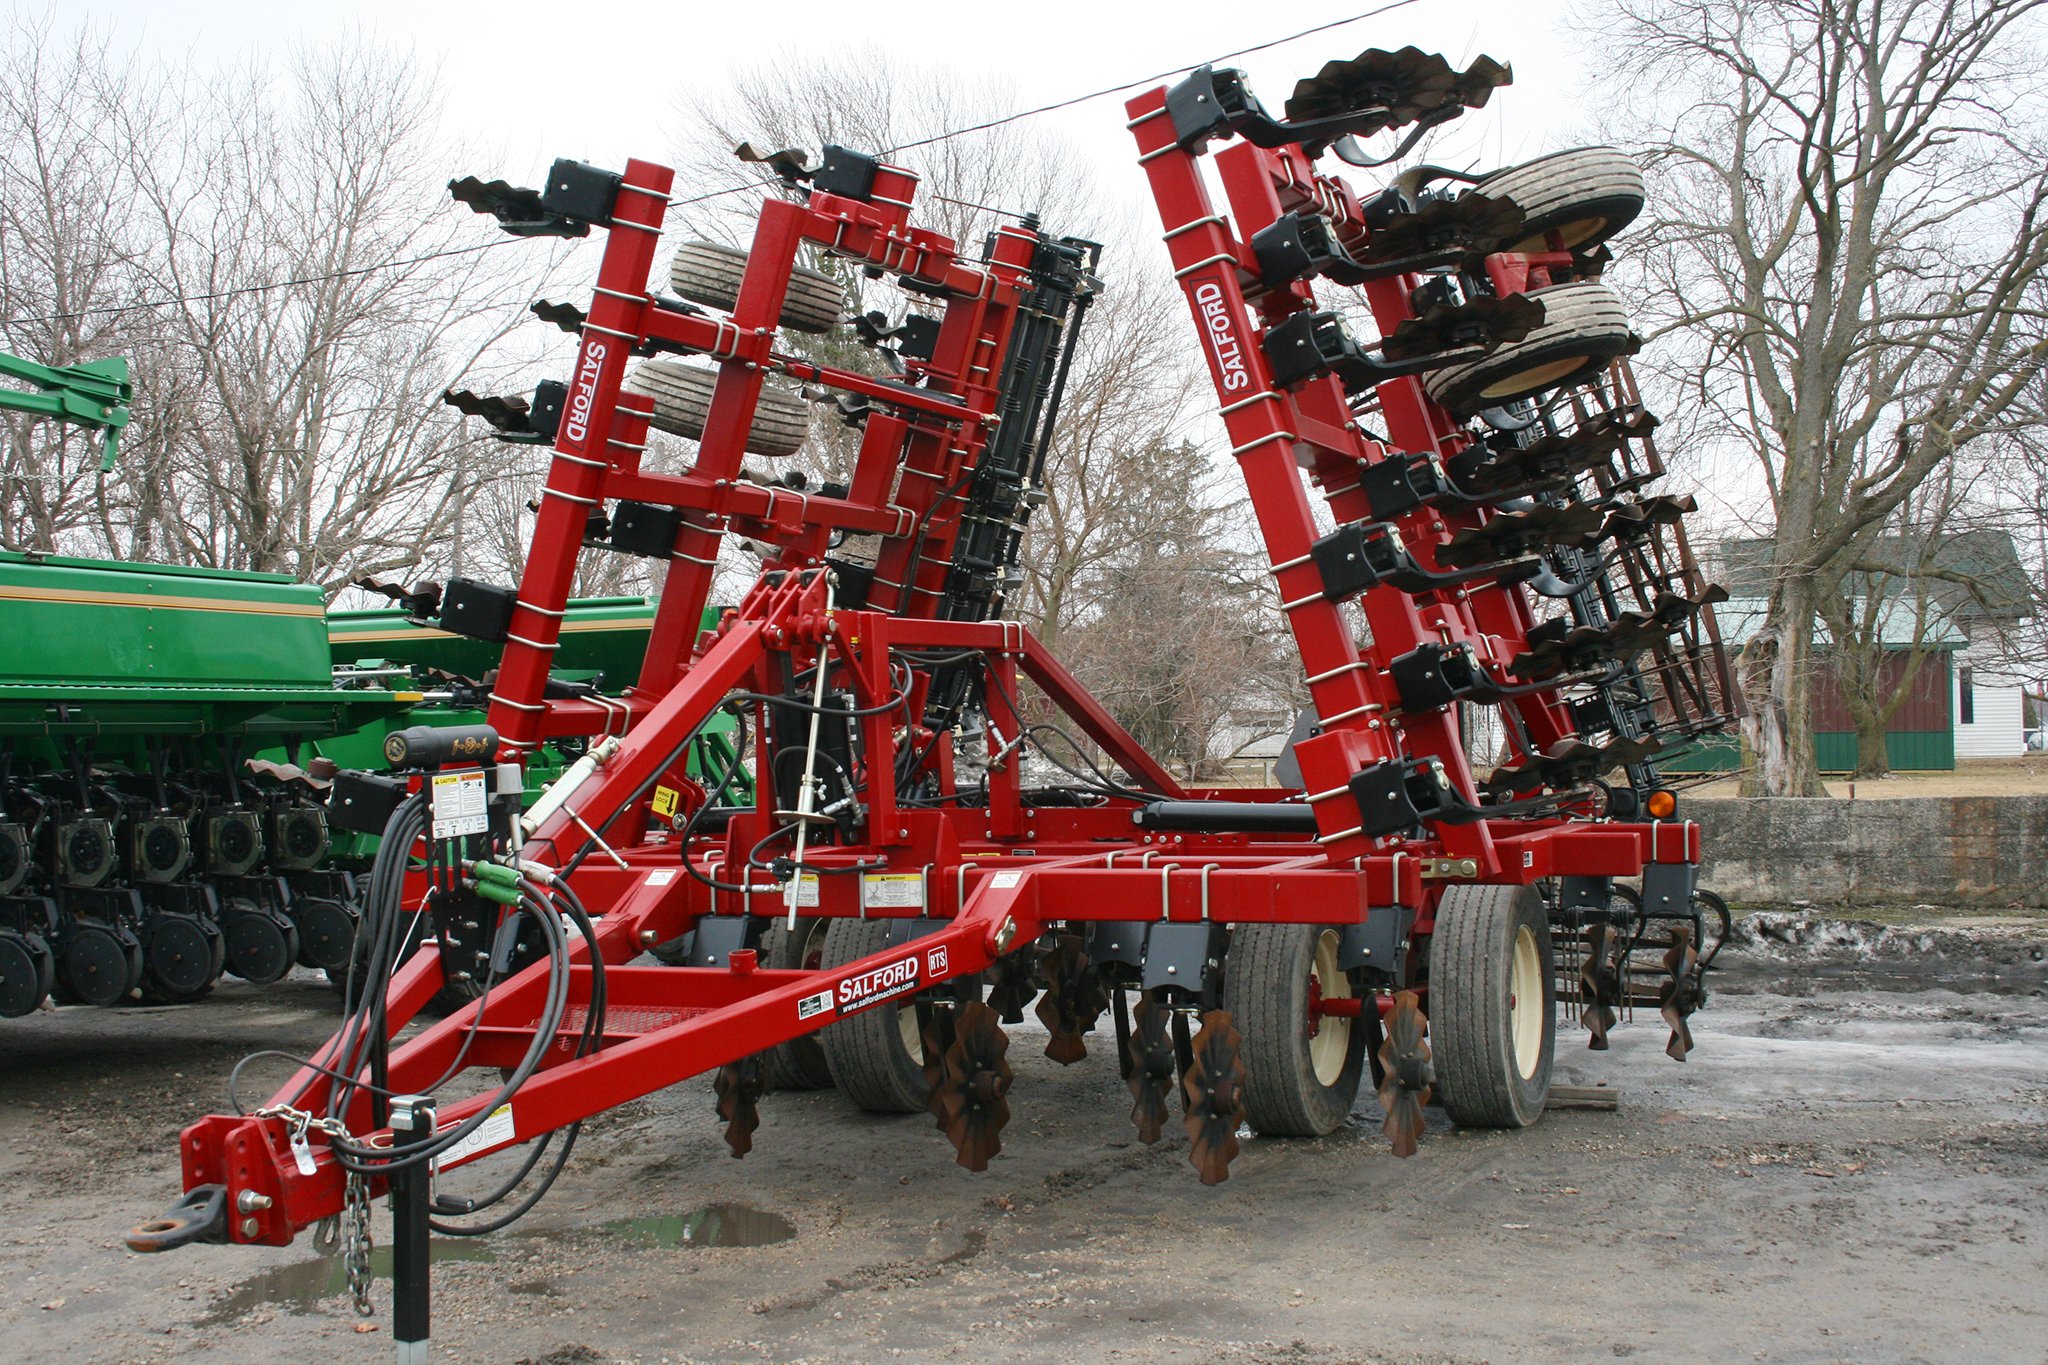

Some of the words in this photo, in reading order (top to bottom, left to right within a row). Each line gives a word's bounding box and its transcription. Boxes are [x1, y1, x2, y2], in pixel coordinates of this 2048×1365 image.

[1196, 283, 1248, 390] SALFORD
[566, 341, 606, 442] SALFORD
[839, 957, 919, 1003] SALFORD
[929, 951, 946, 970] RTS
[842, 981, 915, 1014] www.salfordmachine.com
